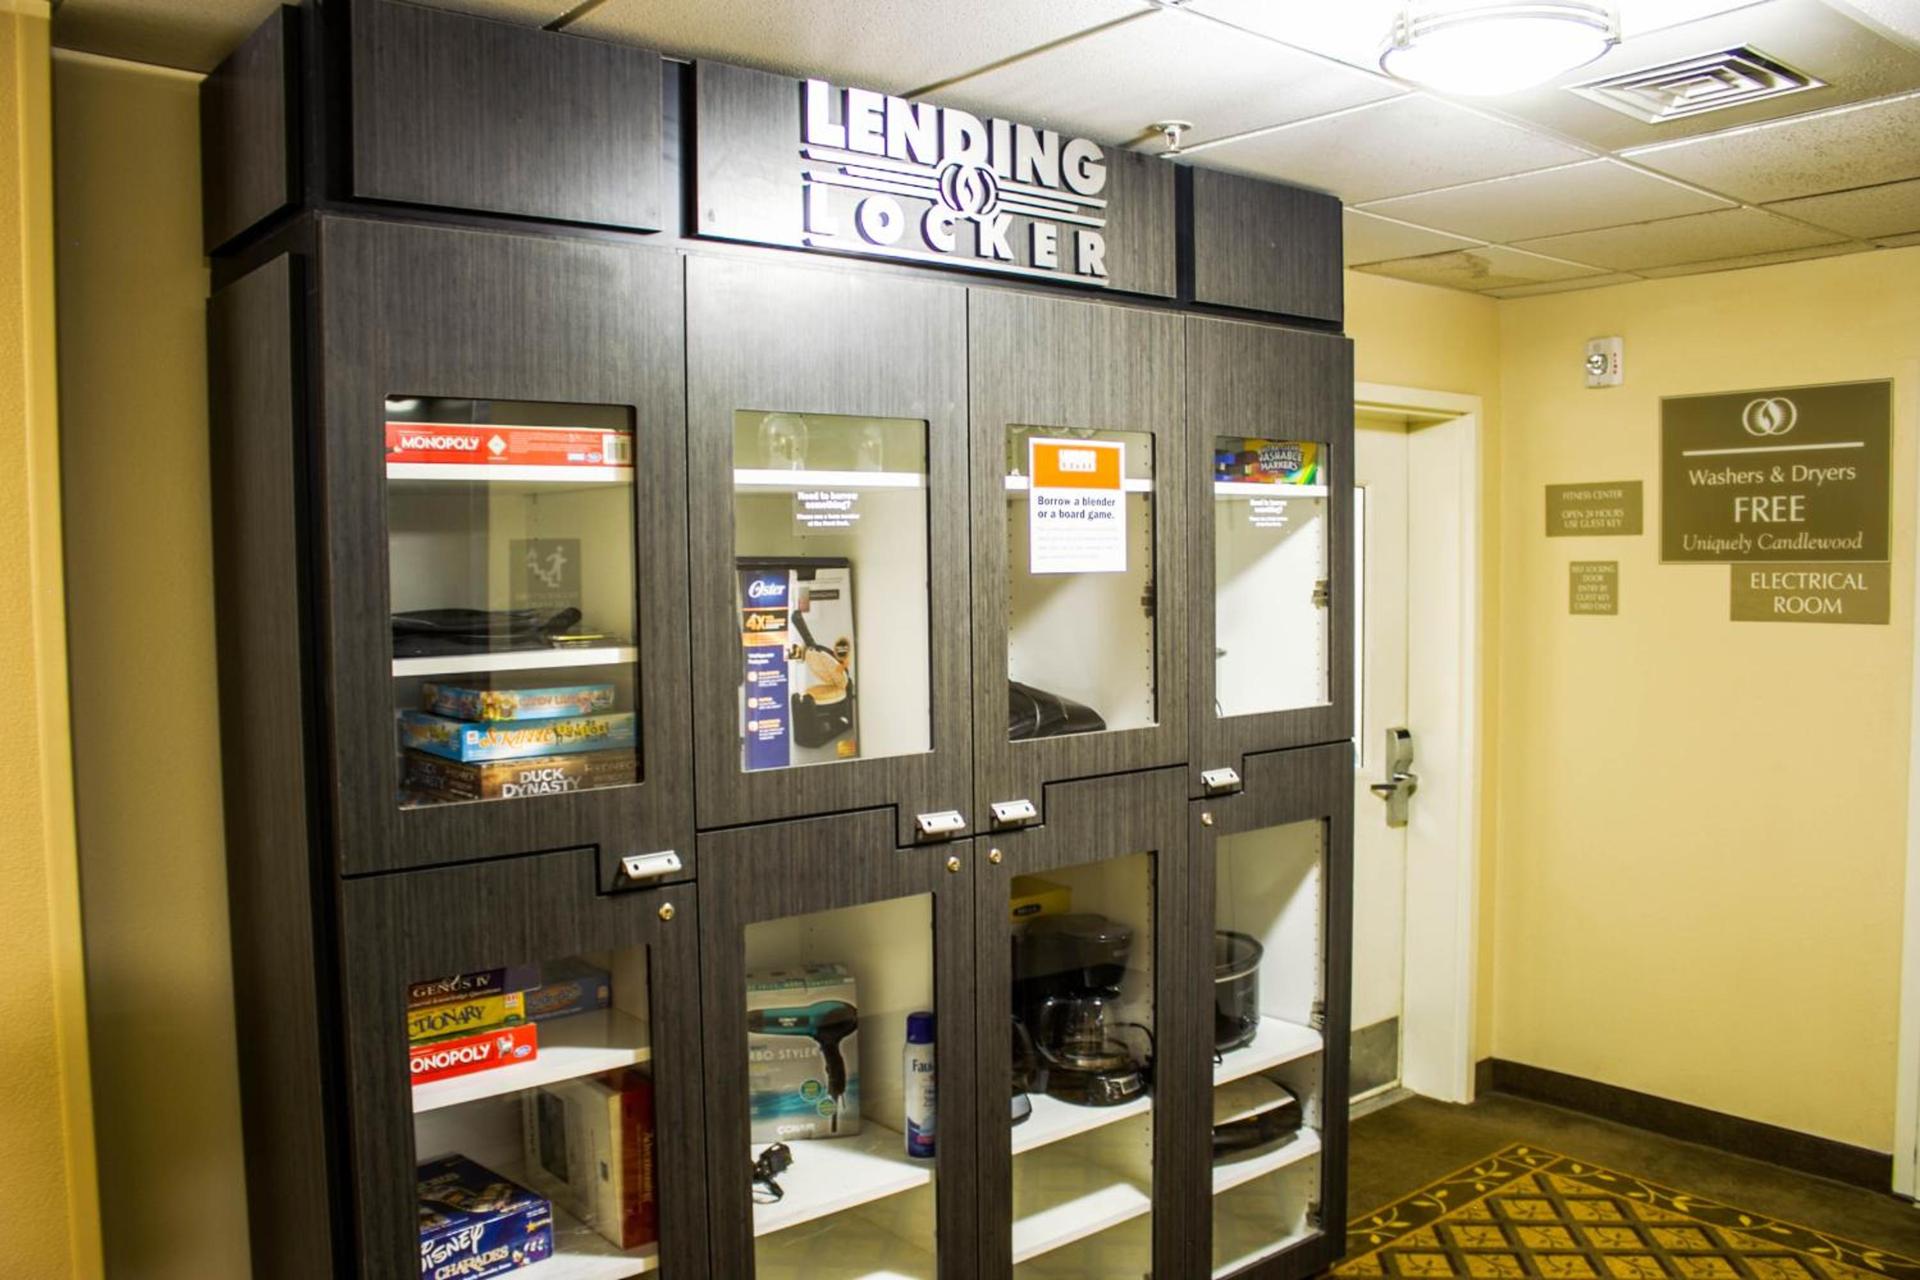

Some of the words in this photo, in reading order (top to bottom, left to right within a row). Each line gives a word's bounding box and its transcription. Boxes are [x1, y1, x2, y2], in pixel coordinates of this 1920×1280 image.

[802, 78, 1107, 196] LENDING
[803, 179, 1108, 277] LOCKER
[400, 435, 480, 452] MONOPOLY
[1688, 467, 1764, 486] Washers
[1770, 465, 1784, 483] &
[1792, 464, 1857, 487] Dryers
[1038, 496, 1071, 506] Borrow
[1074, 498, 1080, 506] a
[1082, 496, 1116, 507] blender
[1734, 495, 1806, 523] FREE
[1038, 510, 1047, 518] or
[1050, 511, 1056, 519] a
[1059, 509, 1085, 519] board
[1088, 510, 1115, 521] game.
[1683, 533, 1752, 554] Uniquely
[1757, 531, 1864, 551] Candlewood
[748, 580, 786, 598] Oster
[1751, 572, 1868, 590] ELECTRICAL
[1774, 596, 1842, 614] ROOM
[746, 613, 766, 630] 4X
[502, 775, 582, 798] DYNASTY
[520, 768, 565, 784] DUCK
[412, 974, 472, 999] GENUS
[476, 974, 491, 987] IV
[407, 1004, 486, 1038] CTIONARY
[410, 1043, 491, 1073] ONOPOLY
[435, 1244, 510, 1280] CHARADES
